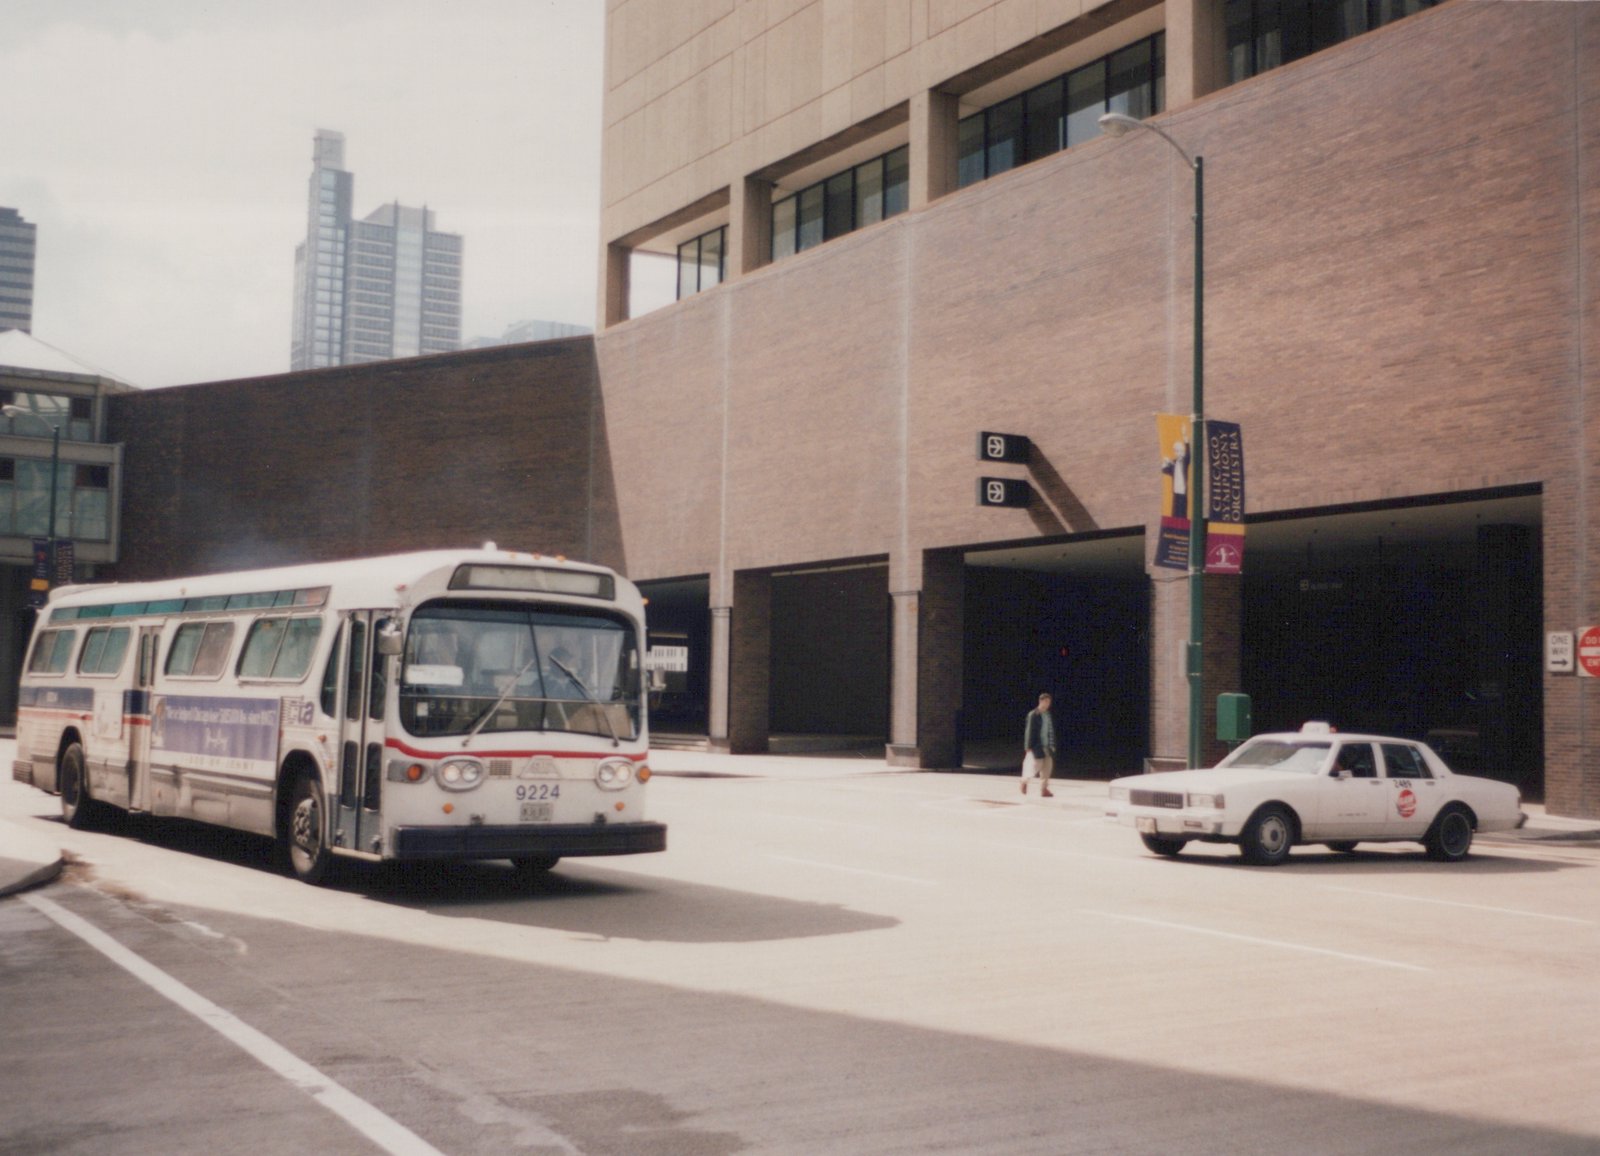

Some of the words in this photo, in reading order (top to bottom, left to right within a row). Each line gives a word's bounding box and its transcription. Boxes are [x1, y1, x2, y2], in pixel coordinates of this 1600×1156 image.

[1211, 436, 1221, 511] CHICAGO
[1220, 432, 1230, 520] SYMPHONY
[1230, 432, 1240, 521] ORCHESTRA
[1551, 635, 1568, 645] ONE
[1551, 647, 1568, 655] WAY
[516, 784, 560, 800] 9224
